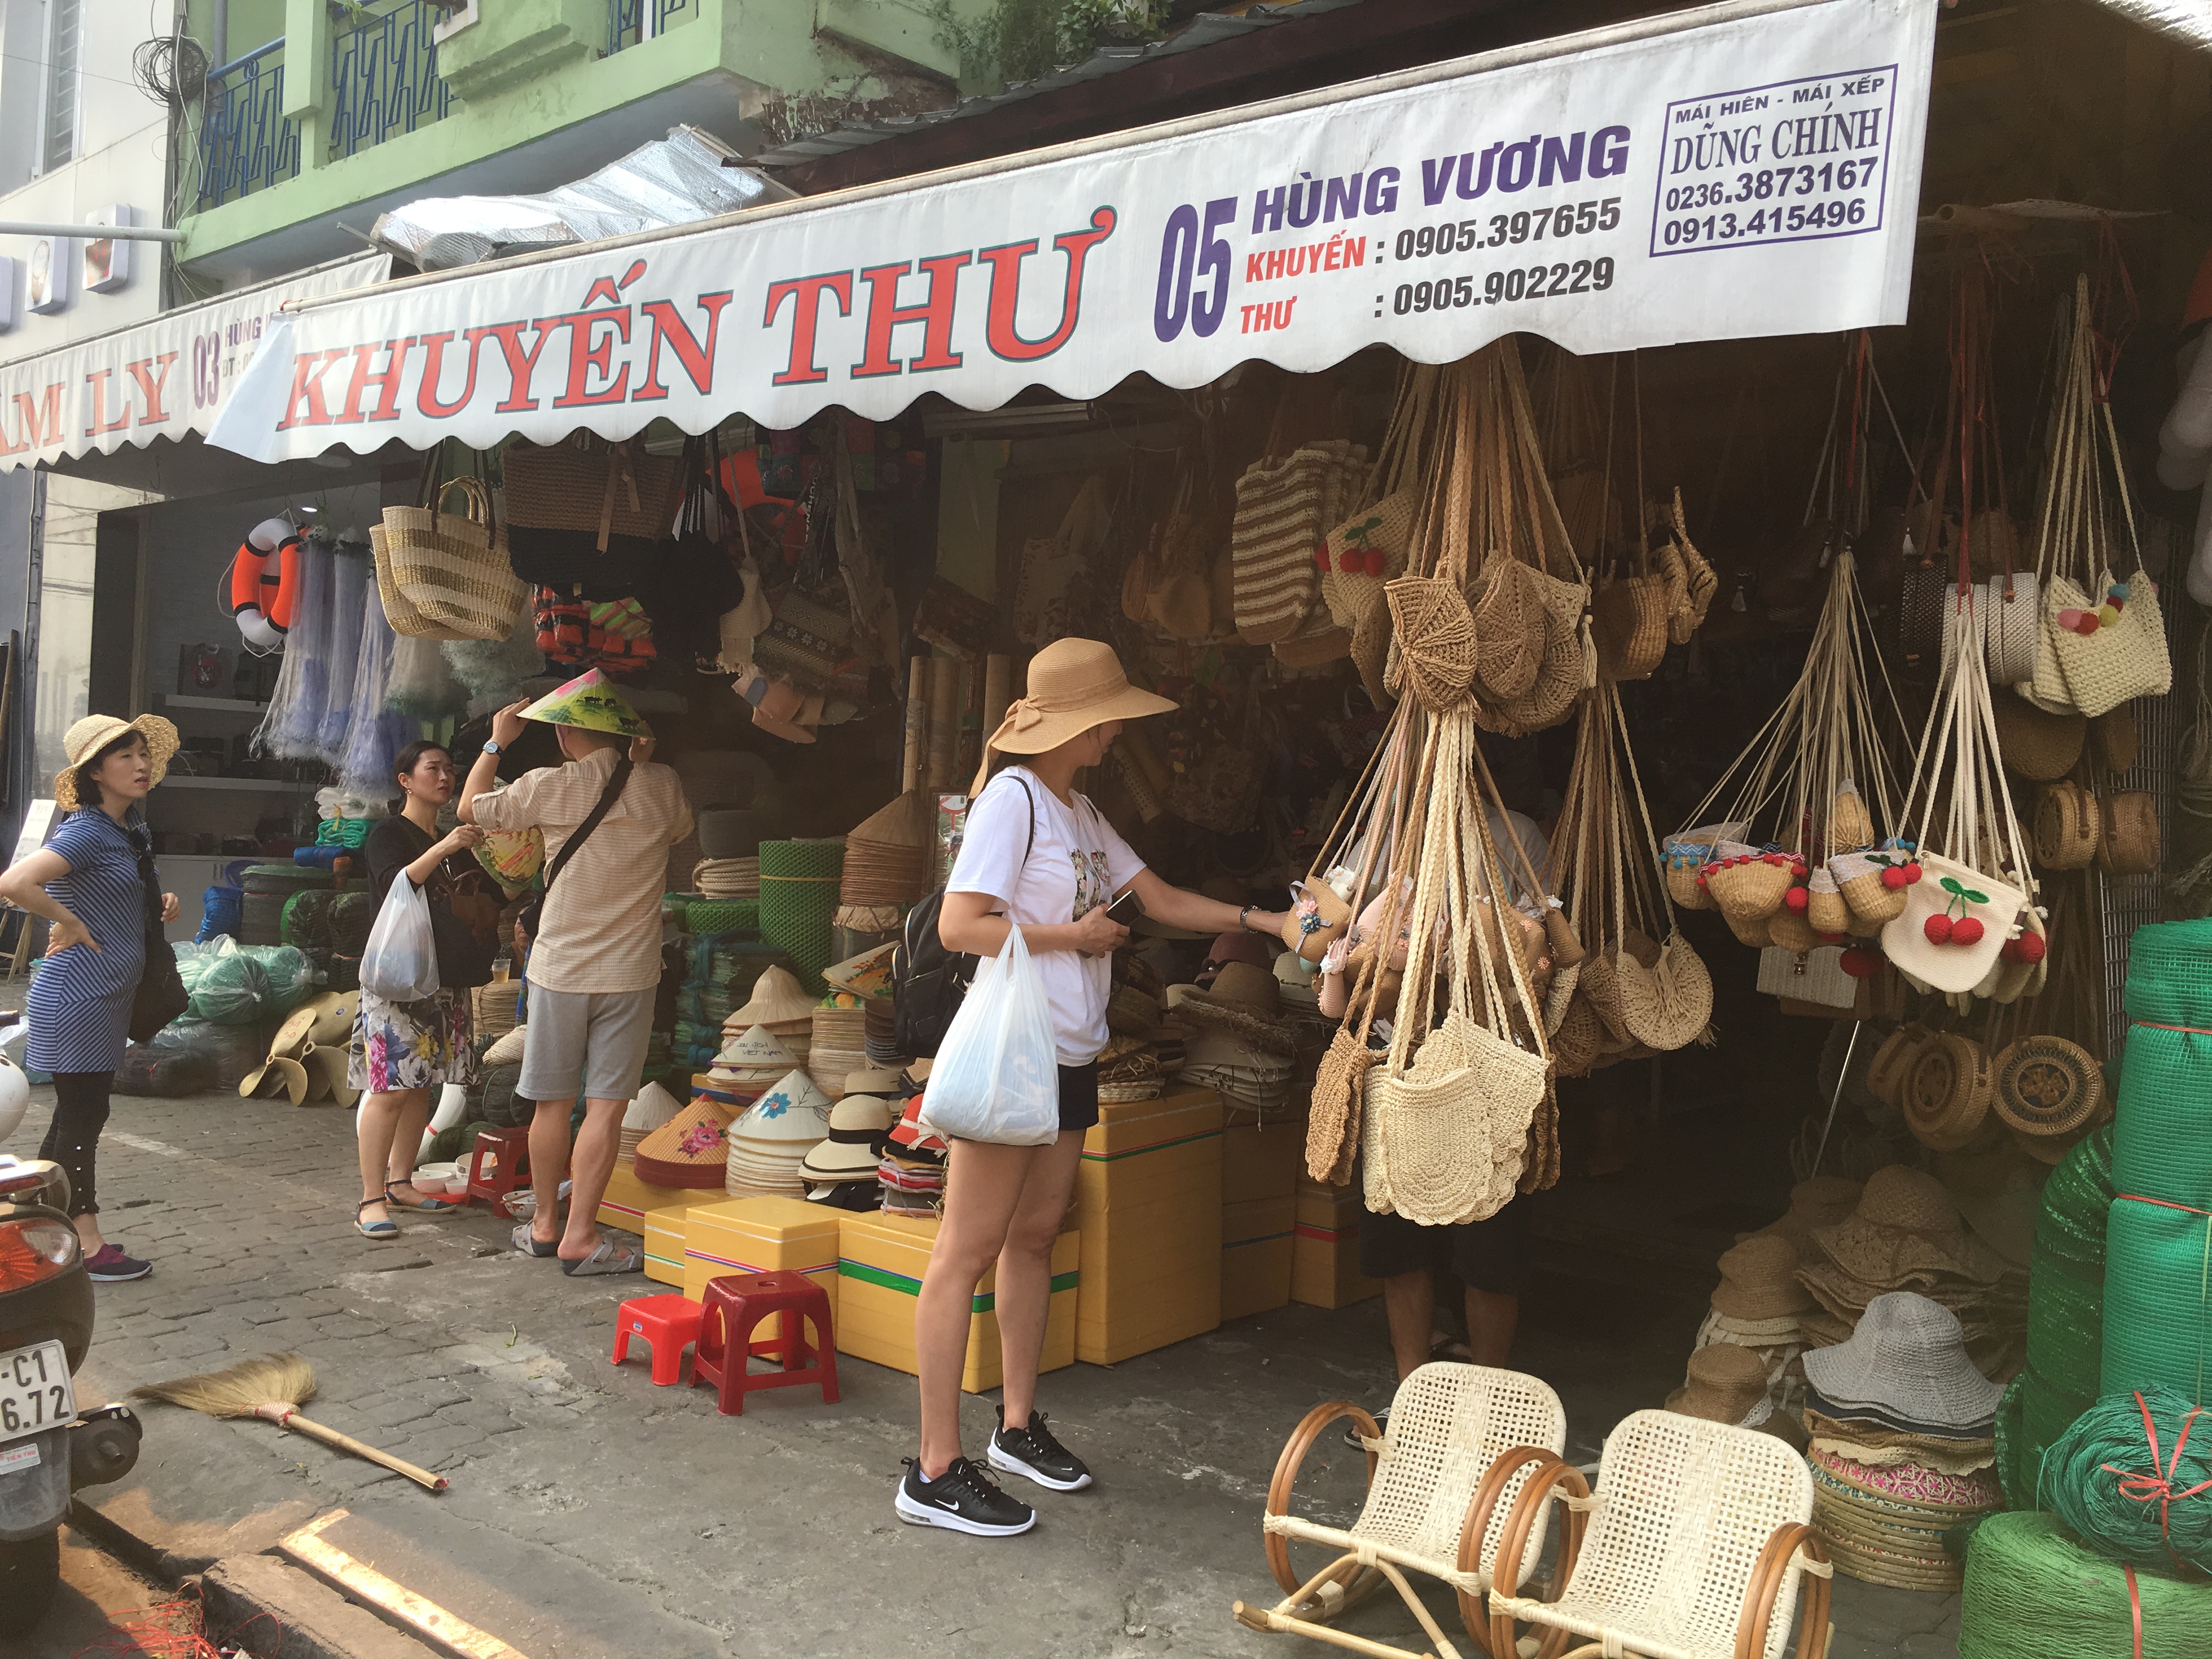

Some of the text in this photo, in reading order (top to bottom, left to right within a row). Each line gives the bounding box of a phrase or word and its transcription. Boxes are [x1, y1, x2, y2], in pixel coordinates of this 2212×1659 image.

[1671, 101, 1882, 174] DŨNG CHÍNH
[1675, 104, 1711, 124] MÁI
[1720, 95, 1768, 116] HIÊN
[1792, 83, 1831, 104] MÁI
[1841, 75, 1885, 97] XẾP
[1251, 125, 1631, 235] HÙNG VƯƠNG
[1666, 156, 1878, 212] 0236.3873167
[1246, 229, 1366, 283] KHUYẾN
[1395, 196, 1622, 261] 0905.397655
[1664, 199, 1865, 246] 0913.415496
[1154, 196, 1238, 342] 05
[1241, 296, 1297, 334] THƯ
[1393, 257, 1615, 315] 0905.902229
[225, 317, 262, 348] HÙNG
[275, 205, 1118, 432] KHUYẾN THƯ
[85, 350, 179, 437] LY
[194, 330, 220, 409] 03
